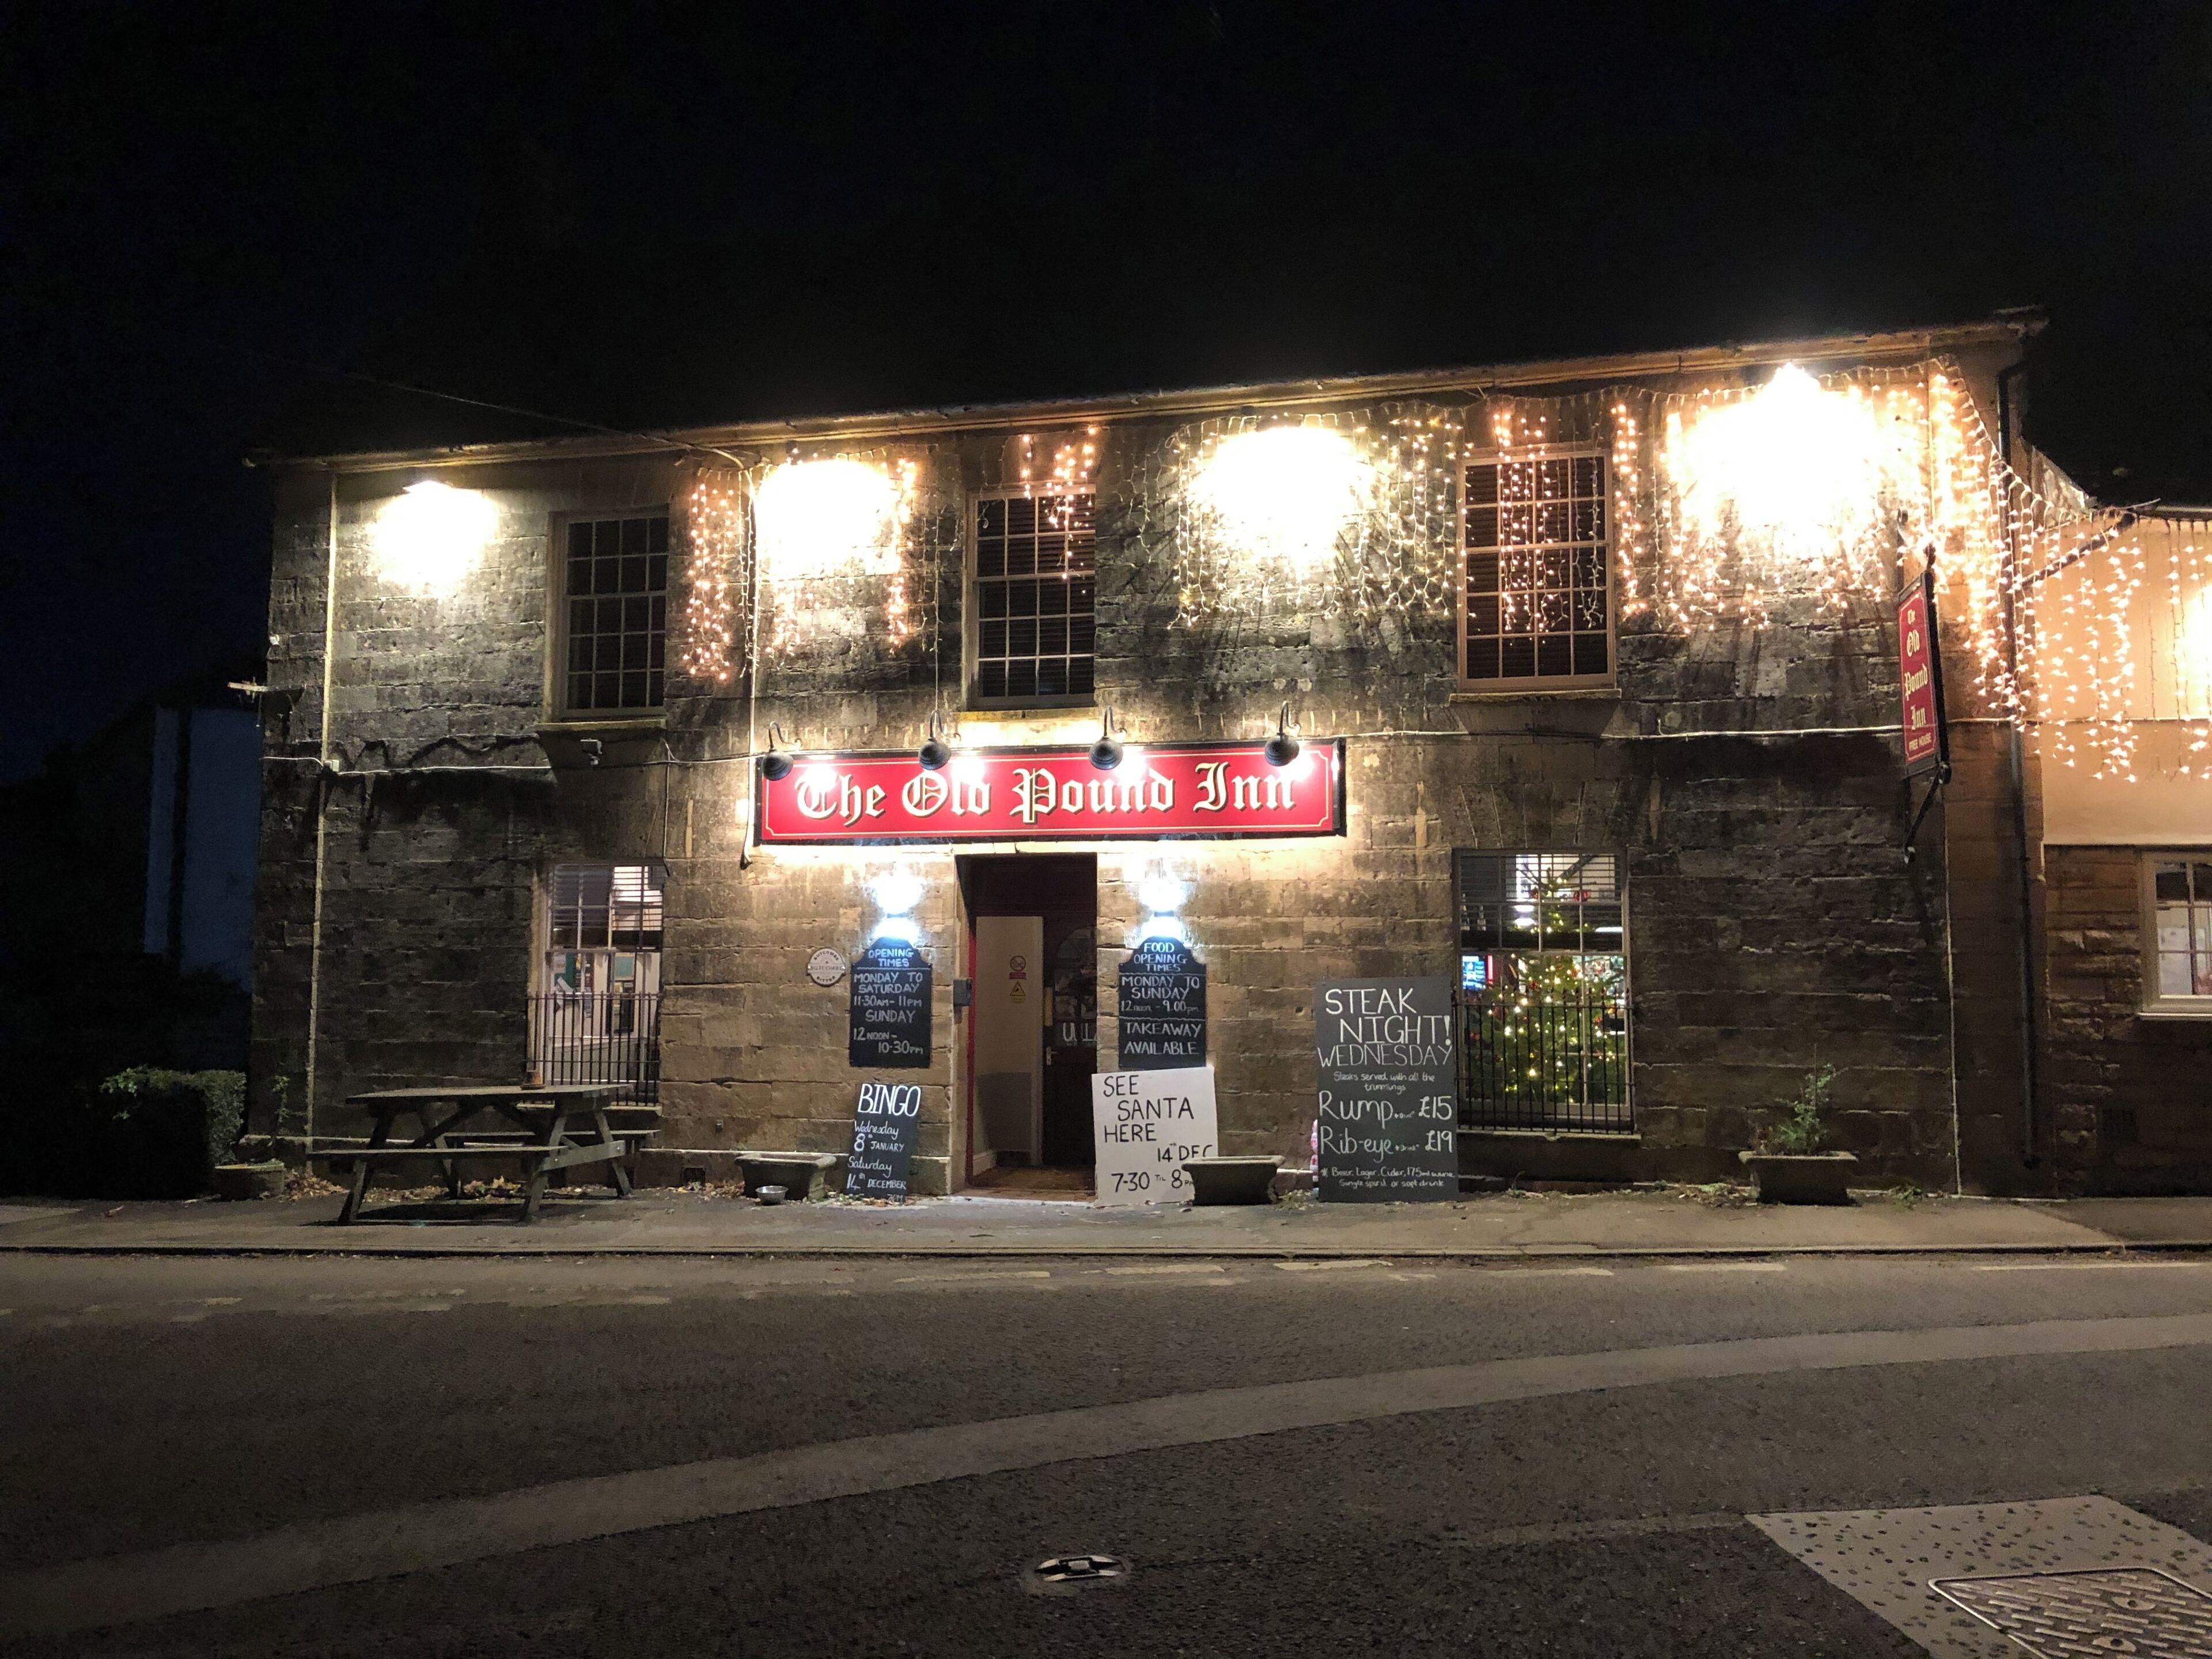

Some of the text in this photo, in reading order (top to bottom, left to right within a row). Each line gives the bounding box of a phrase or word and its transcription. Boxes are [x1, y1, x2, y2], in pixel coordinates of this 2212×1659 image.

[1907, 629, 1920, 657] Old
[1904, 664, 1929, 701] Pound
[1910, 706, 1926, 730] Inn
[794, 762, 1298, 827] The Old Pound Inn
[868, 948, 914, 959] OPENING
[1143, 942, 1175, 953] FOOD
[878, 959, 910, 967] TIMES
[1134, 954, 1188, 964] OPENING
[1146, 964, 1181, 972] TIMES
[854, 972, 923, 983] MONDAY TO
[1122, 976, 1200, 989] MONDAY TO
[858, 983, 920, 994] SATURDAY
[1131, 987, 1190, 1000] SUNDAY
[899, 995, 922, 1007] 11PM
[1325, 987, 1417, 1014] STEAK
[865, 1009, 916, 1023] SUNDAY
[1340, 1015, 1450, 1046] NIGHT!
[1124, 1041, 1200, 1056] AVAILABLE
[1317, 1044, 1452, 1068] WEDNESDAY
[1334, 1071, 1358, 1082] Steaks
[1390, 1072, 1407, 1081] with
[1408, 1071, 1419, 1081] all
[1422, 1071, 1435, 1082] the
[1103, 1075, 1139, 1097] SEE
[1364, 1082, 1406, 1095] trimmings
[857, 1083, 921, 1116] BINGO
[1118, 1097, 1194, 1121] SANTA
[1319, 1090, 1394, 1130] Rump
[1418, 1095, 1452, 1120] £15
[854, 1120, 899, 1140] Wednesday
[1104, 1123, 1157, 1143] HERE
[870, 1141, 904, 1152] JANUARY
[1179, 1144, 1213, 1161] DEC
[1320, 1126, 1394, 1164] Rib-eye
[1425, 1130, 1452, 1153] £19
[847, 1156, 892, 1178] Saturday
[1407, 1166, 1430, 1177] 175ml
[867, 1179, 906, 1190] DECEMBER
[1111, 1171, 1150, 1192] 7-30
[1339, 1179, 1363, 1190] Single
[1402, 1179, 1418, 1189] soft
